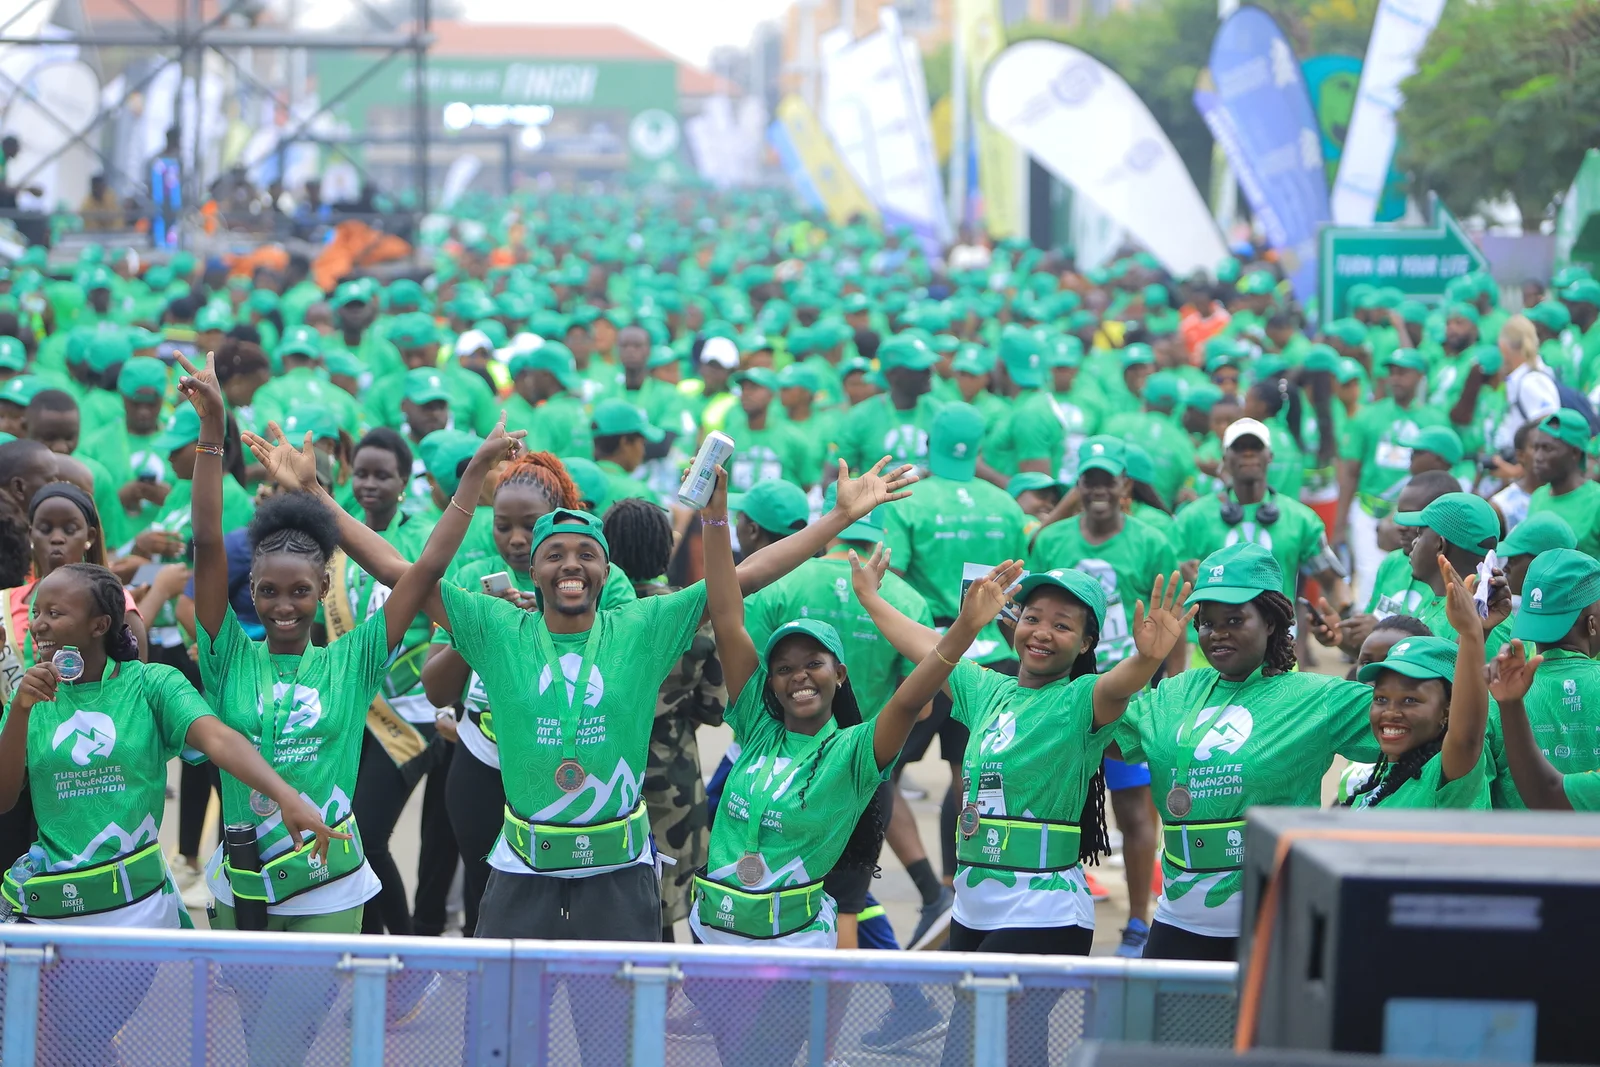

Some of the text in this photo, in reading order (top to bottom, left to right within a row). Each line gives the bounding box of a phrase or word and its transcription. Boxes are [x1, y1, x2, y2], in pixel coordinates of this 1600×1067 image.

[1336, 254, 1470, 278] TURN ON YOUR LITE
[1562, 695, 1582, 706] TUSKER
[1571, 703, 1582, 712] LITE
[583, 715, 606, 726] LITE
[536, 725, 606, 737] MT RNZORI
[298, 736, 323, 745] LITE
[536, 734, 606, 746] MARTHON
[985, 762, 1003, 770] LITE
[1171, 763, 1243, 777] TSKER LITE
[53, 765, 122, 781] TUSKER LITE
[56, 779, 73, 791] MT
[58, 784, 126, 800] MARATHON
[1190, 786, 1243, 799] RATHON
[739, 807, 783, 829] RWZORI
[572, 850, 594, 859] TUSKER
[982, 845, 1001, 855] TUSKER
[1225, 846, 1245, 857] TUSKE
[581, 857, 594, 865] LITE
[989, 854, 1001, 863] LITE
[1236, 854, 1244, 863] LIT
[308, 865, 329, 881] TUSKER
[319, 872, 330, 882] LITE
[61, 898, 84, 908] TUSKER
[73, 904, 85, 912] LITE
[716, 911, 735, 922] TUSKER
[724, 920, 735, 929] LITE
